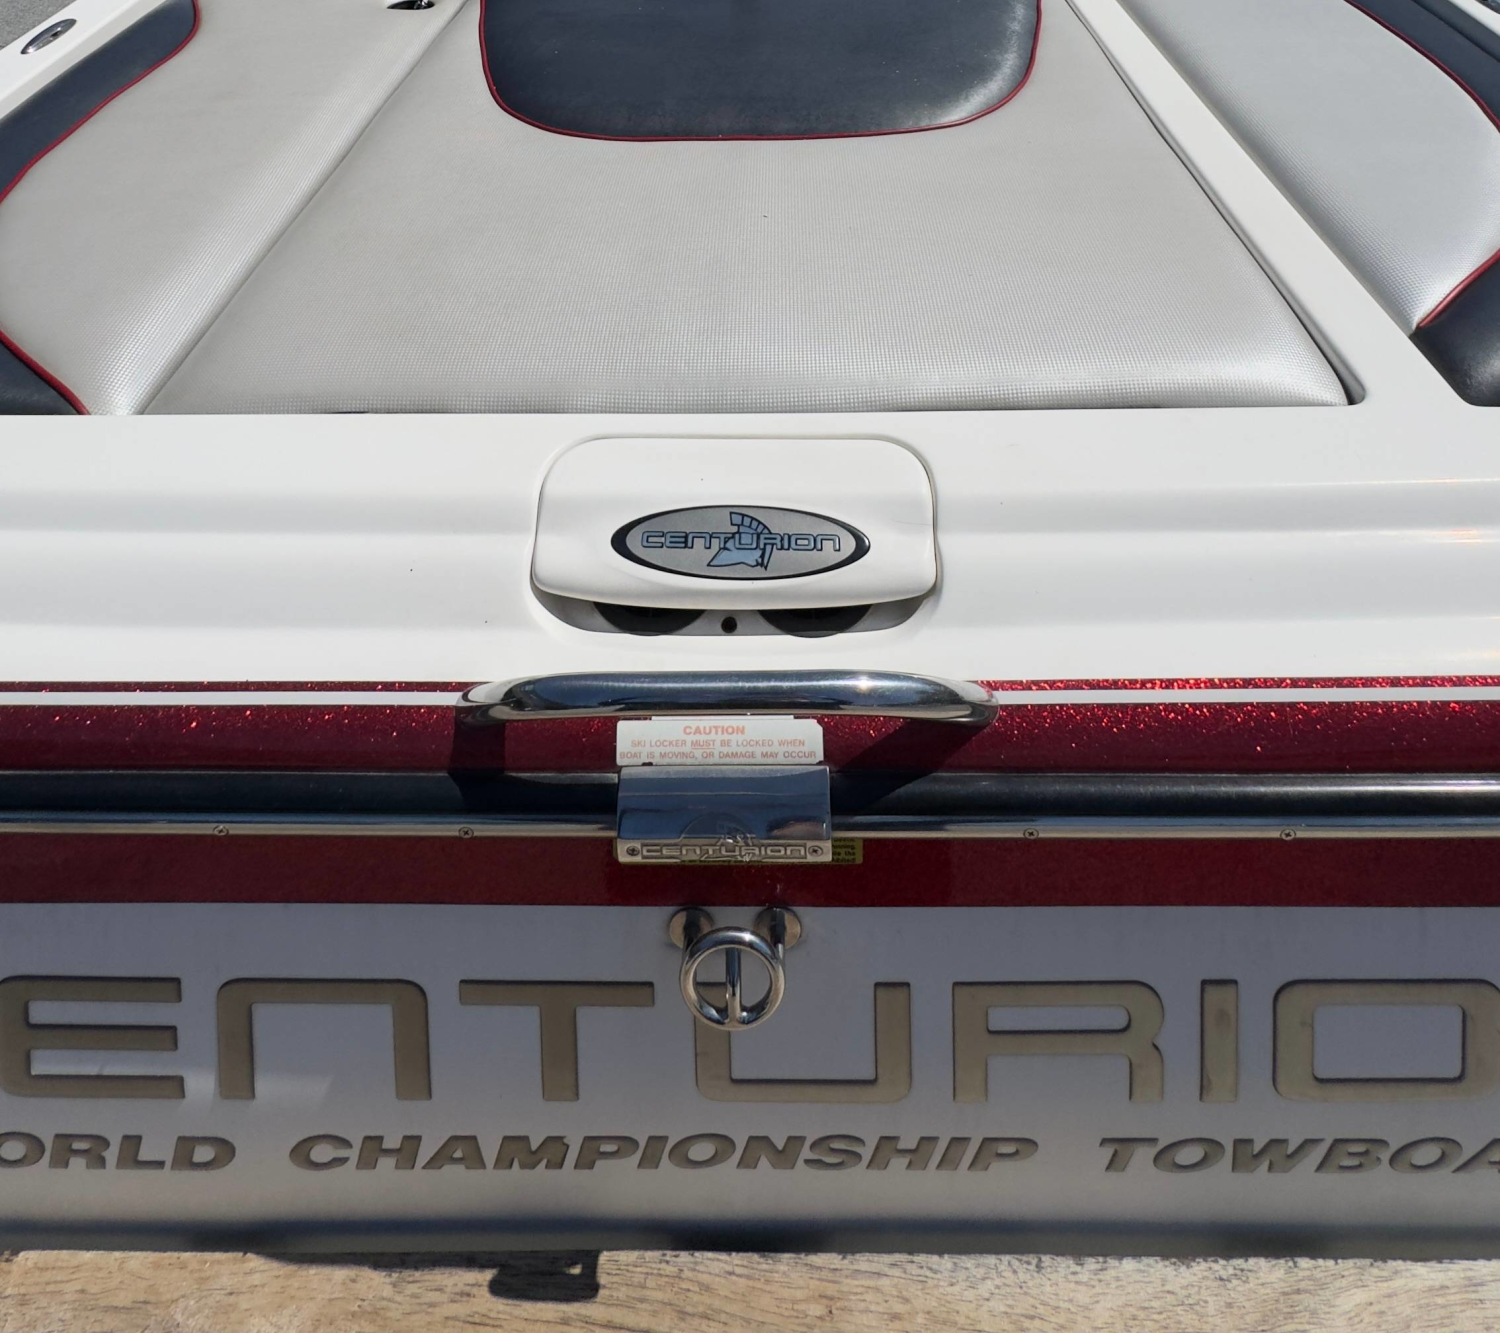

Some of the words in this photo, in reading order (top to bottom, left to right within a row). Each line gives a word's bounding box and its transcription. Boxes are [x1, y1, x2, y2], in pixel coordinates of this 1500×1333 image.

[640, 530, 841, 552] CENTURION
[682, 725, 746, 736] CAUTION
[630, 739, 646, 748] SKI
[649, 739, 687, 748] LOCKER
[690, 738, 716, 748] MUST
[720, 738, 732, 747] BE
[736, 738, 774, 747] LOCKED
[777, 738, 805, 747] WHEN
[619, 751, 643, 760] BOAT
[646, 751, 656, 760] IS
[659, 751, 698, 761] MOVING,
[701, 751, 715, 760] OR
[718, 750, 757, 759] DAMAGE
[760, 750, 779, 759] MAY
[782, 750, 817, 759] OCCUR
[642, 845, 806, 857] CENTURION
[0, 1131, 237, 1171] ORLD
[289, 1133, 1039, 1172] CHAMPIONSHIP
